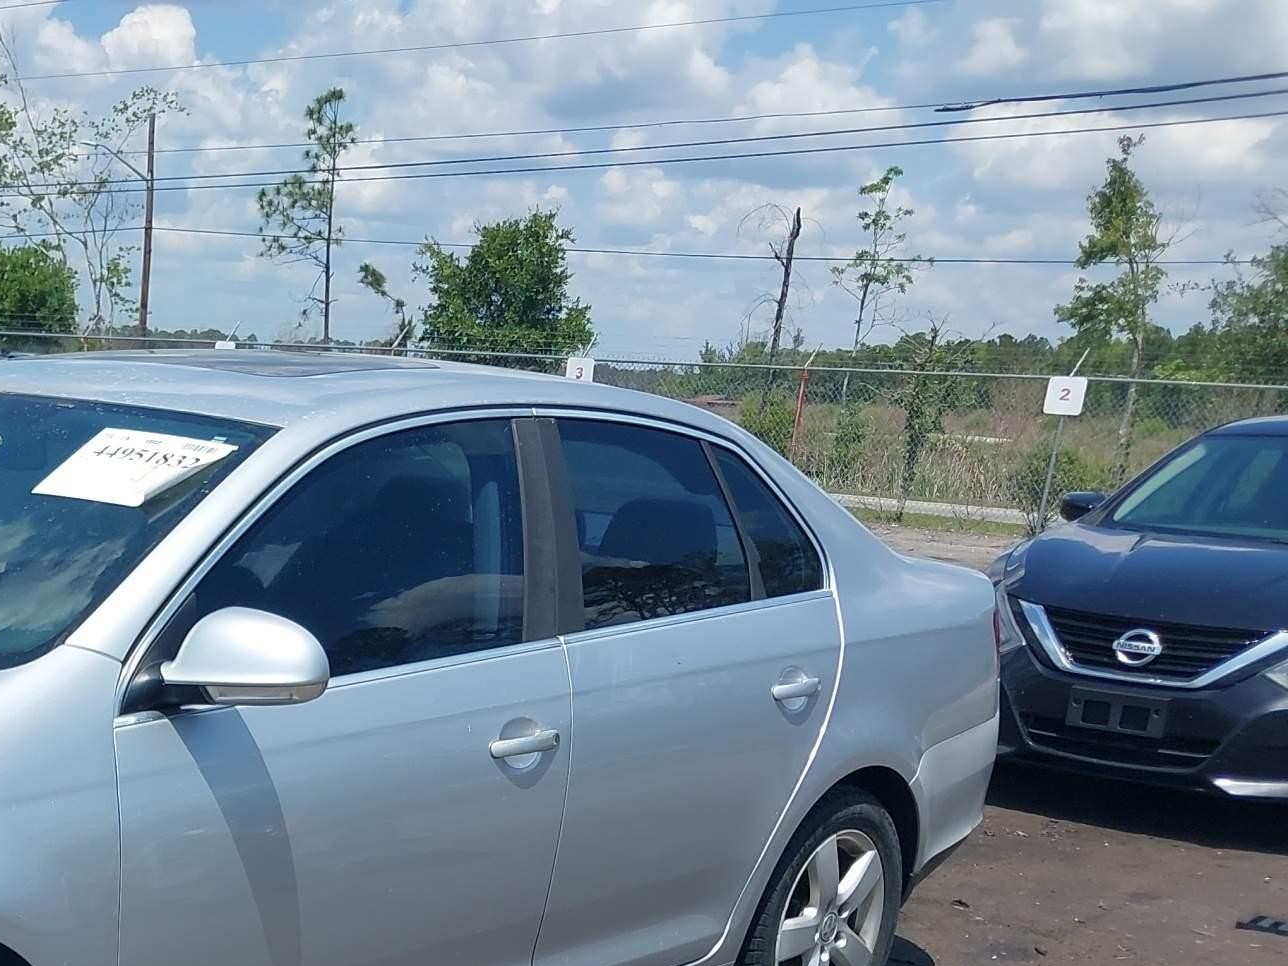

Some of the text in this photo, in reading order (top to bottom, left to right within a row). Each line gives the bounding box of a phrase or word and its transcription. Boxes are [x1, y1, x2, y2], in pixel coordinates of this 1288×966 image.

[575, 367, 584, 379] 3
[1059, 388, 1071, 401] 2
[93, 444, 201, 468] 44951832
[1116, 641, 1156, 653] NISSAN
